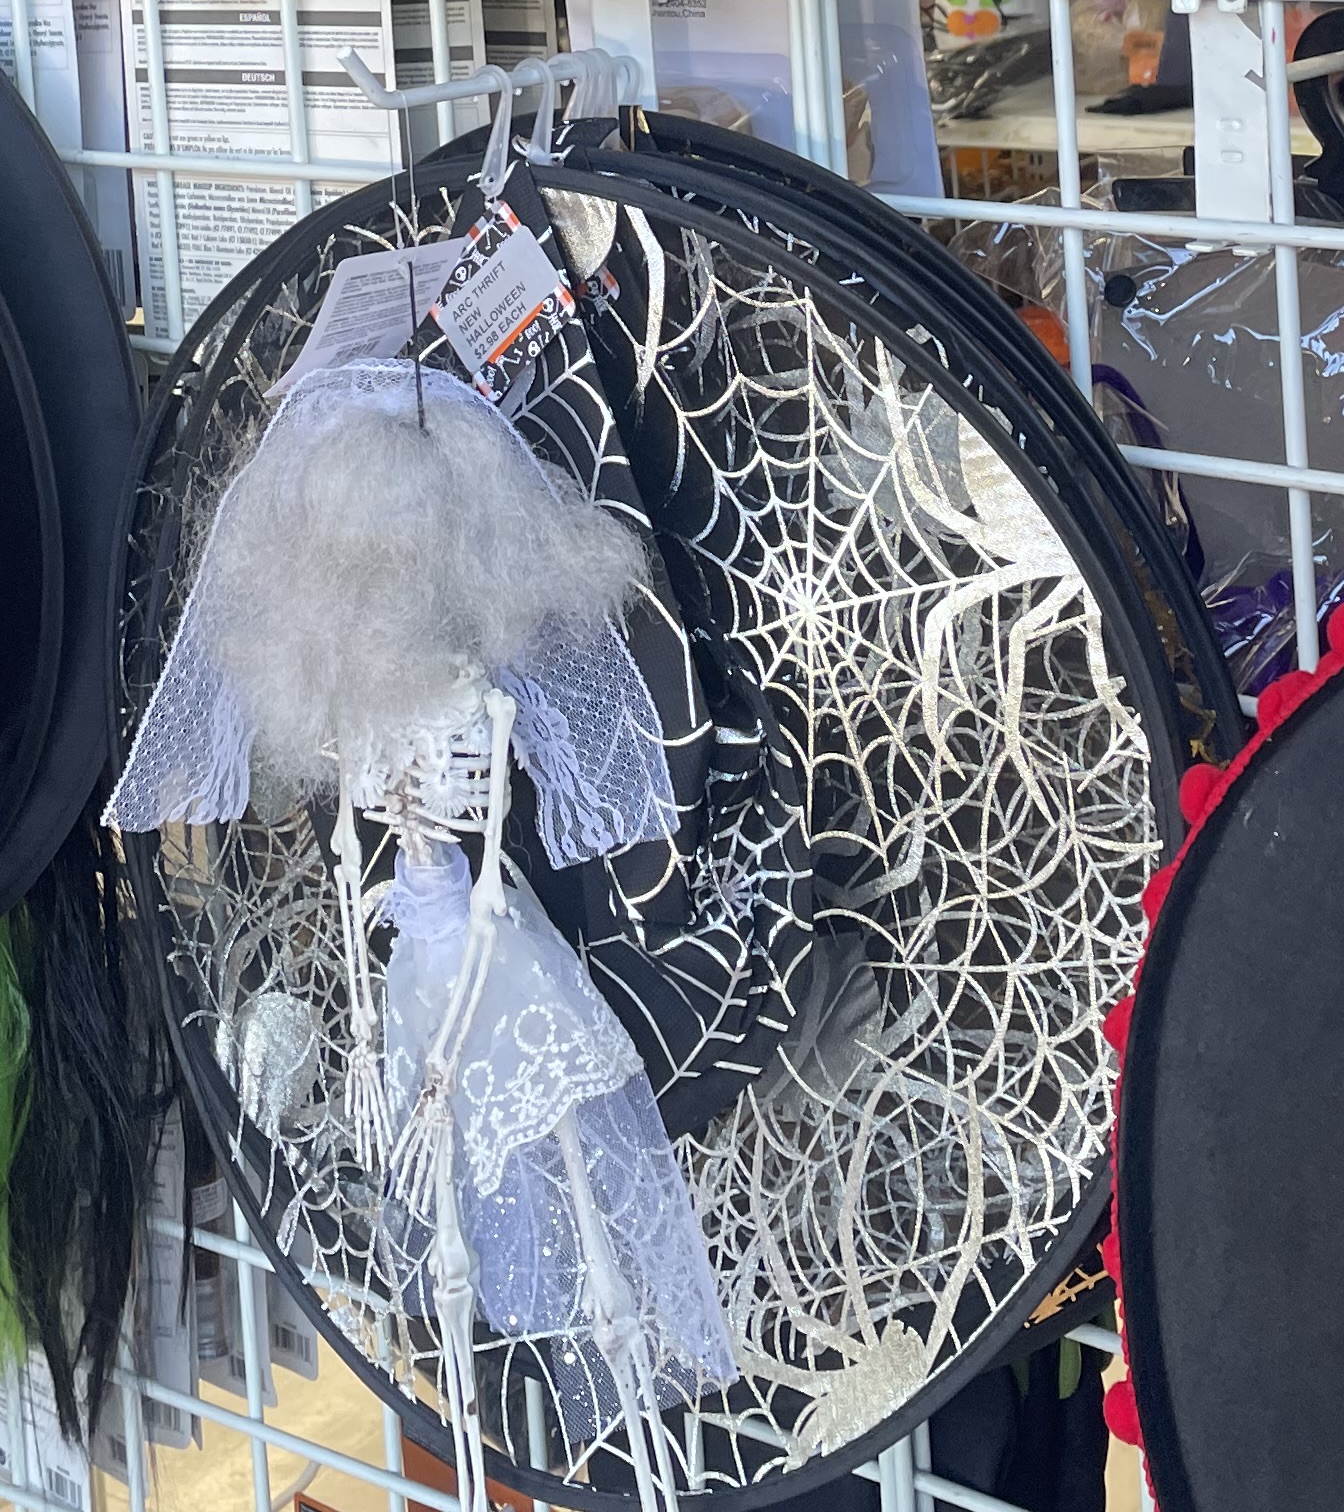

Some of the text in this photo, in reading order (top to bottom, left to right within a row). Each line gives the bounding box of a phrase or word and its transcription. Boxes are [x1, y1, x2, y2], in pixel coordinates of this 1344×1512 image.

[452, 260, 506, 322] ARC THRIFT
[458, 306, 483, 335] NEW
[466, 281, 527, 347] HALLOWEEN
[474, 301, 527, 360] $2.98 EACH
